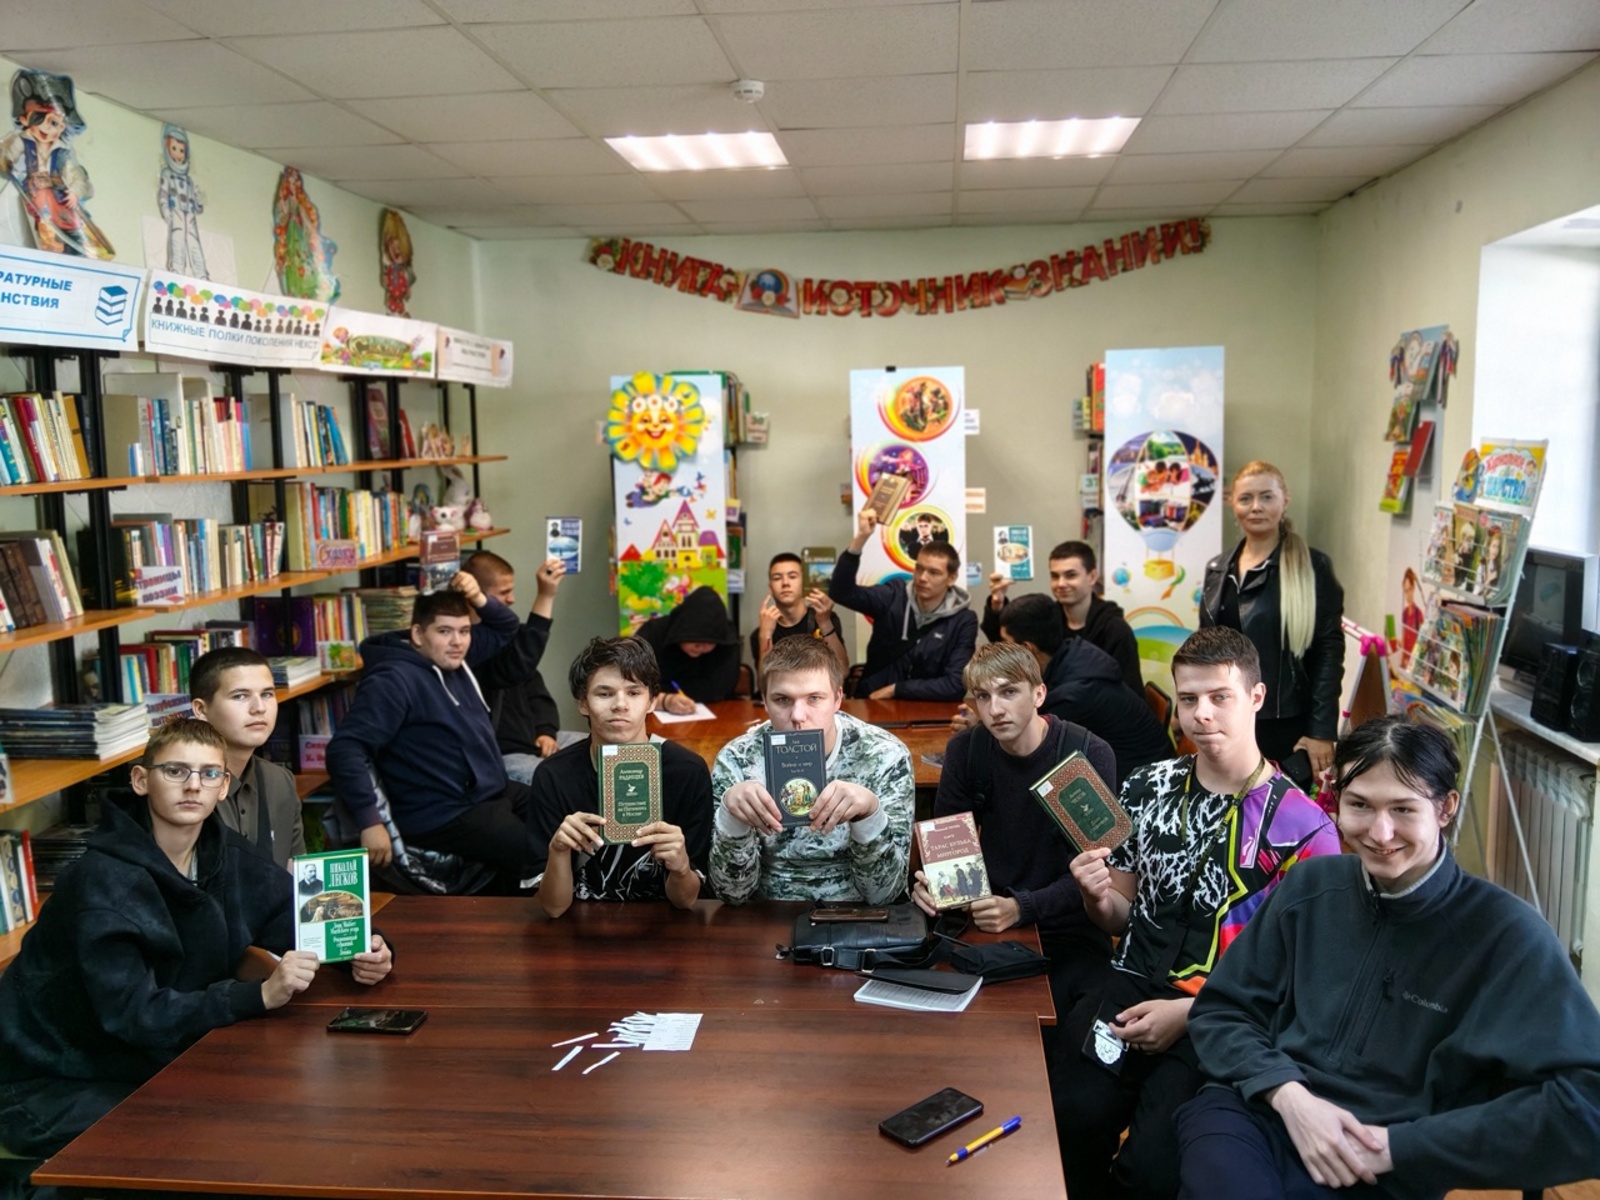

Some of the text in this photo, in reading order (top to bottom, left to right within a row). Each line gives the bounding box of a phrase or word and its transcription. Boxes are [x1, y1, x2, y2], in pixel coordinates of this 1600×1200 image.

[1, 291, 59, 309] НСТВИЯ
[151, 318, 205, 338] КНИЖНЫЕ
[208, 328, 244, 343] ПОЛКИ
[245, 334, 293, 347] ПОКОЛЕНИЯ
[775, 743, 817, 755] ТОЛСТОЙ
